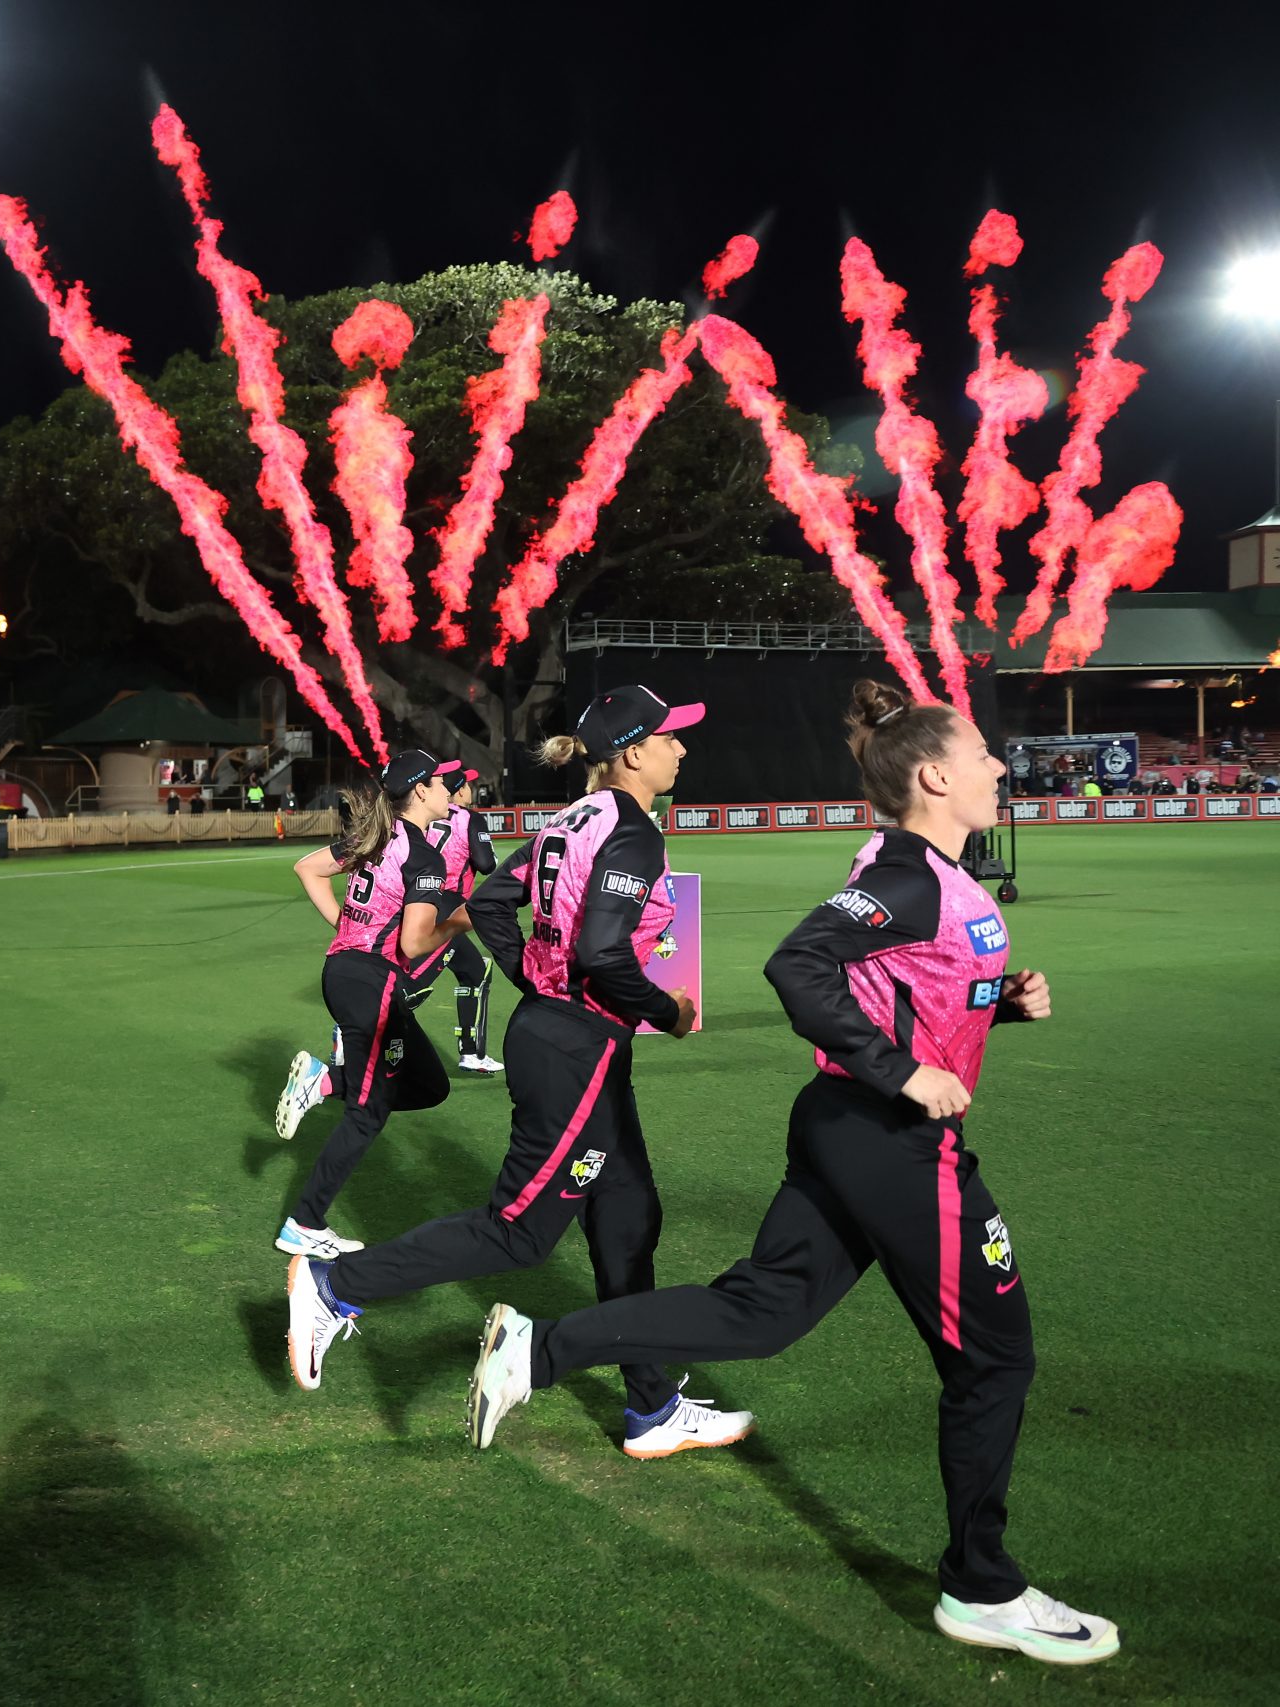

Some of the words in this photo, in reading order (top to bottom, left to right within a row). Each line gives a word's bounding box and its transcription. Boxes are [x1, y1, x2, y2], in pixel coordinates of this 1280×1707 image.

[486, 809, 505, 831] ber
[678, 808, 710, 828] weber
[729, 807, 758, 826] weber
[778, 806, 808, 825] weber
[826, 805, 856, 823] weber
